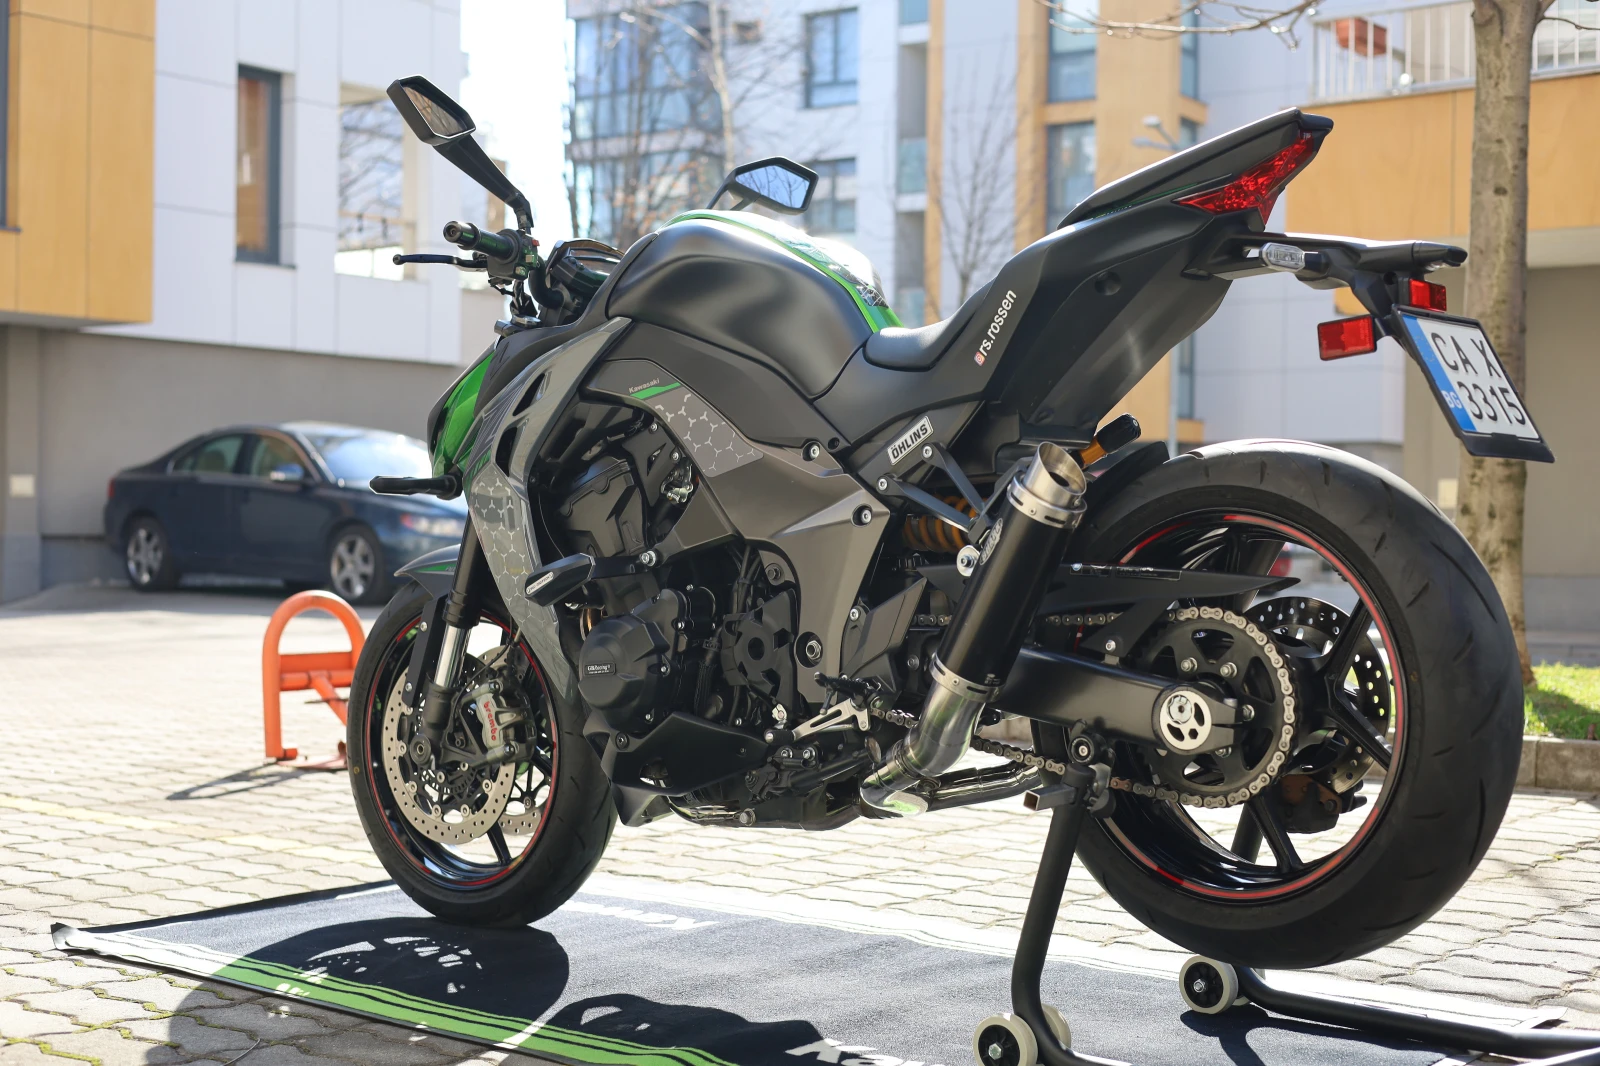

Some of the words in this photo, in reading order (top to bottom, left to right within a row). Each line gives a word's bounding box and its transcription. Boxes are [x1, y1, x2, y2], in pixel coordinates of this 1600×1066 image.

[979, 290, 1017, 357] rs.rossen
[1431, 332, 1478, 375] CA
[1470, 338, 1502, 379] X
[629, 378, 660, 393] Kawasaki
[1441, 390, 1463, 409] BG
[1457, 381, 1526, 426] 3315
[891, 423, 928, 460] ÖHLINS
[484, 701, 497, 741] brembo
